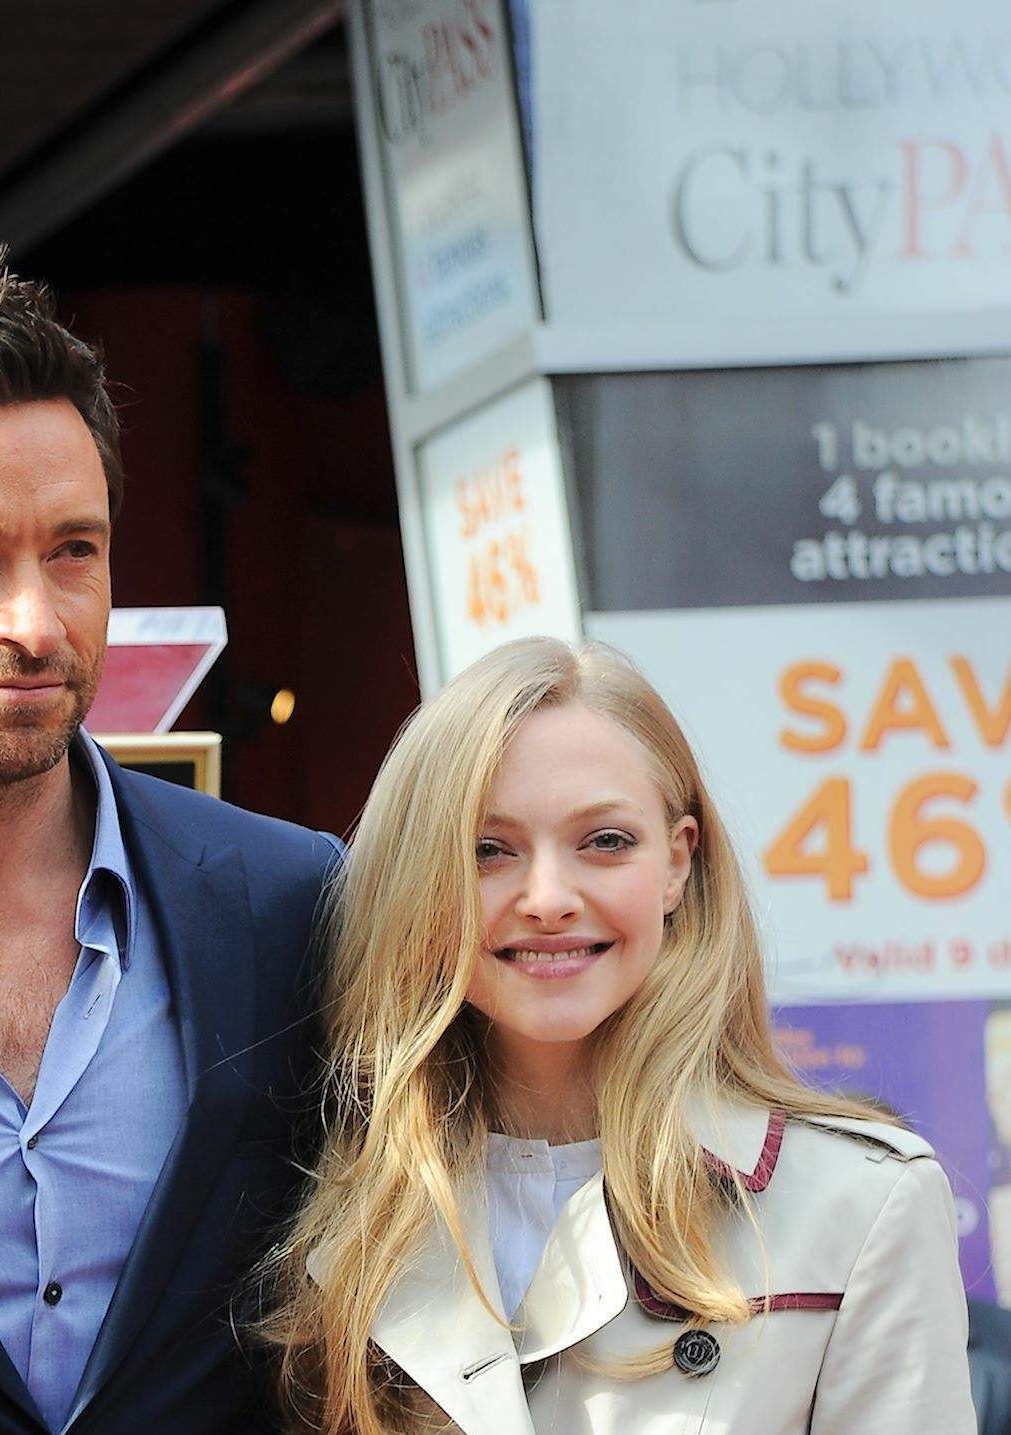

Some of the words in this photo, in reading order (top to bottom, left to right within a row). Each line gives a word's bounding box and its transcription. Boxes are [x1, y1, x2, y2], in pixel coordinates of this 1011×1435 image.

[812, 421, 838, 471] 1
[818, 473, 861, 525] 4
[872, 469, 1011, 524] famo
